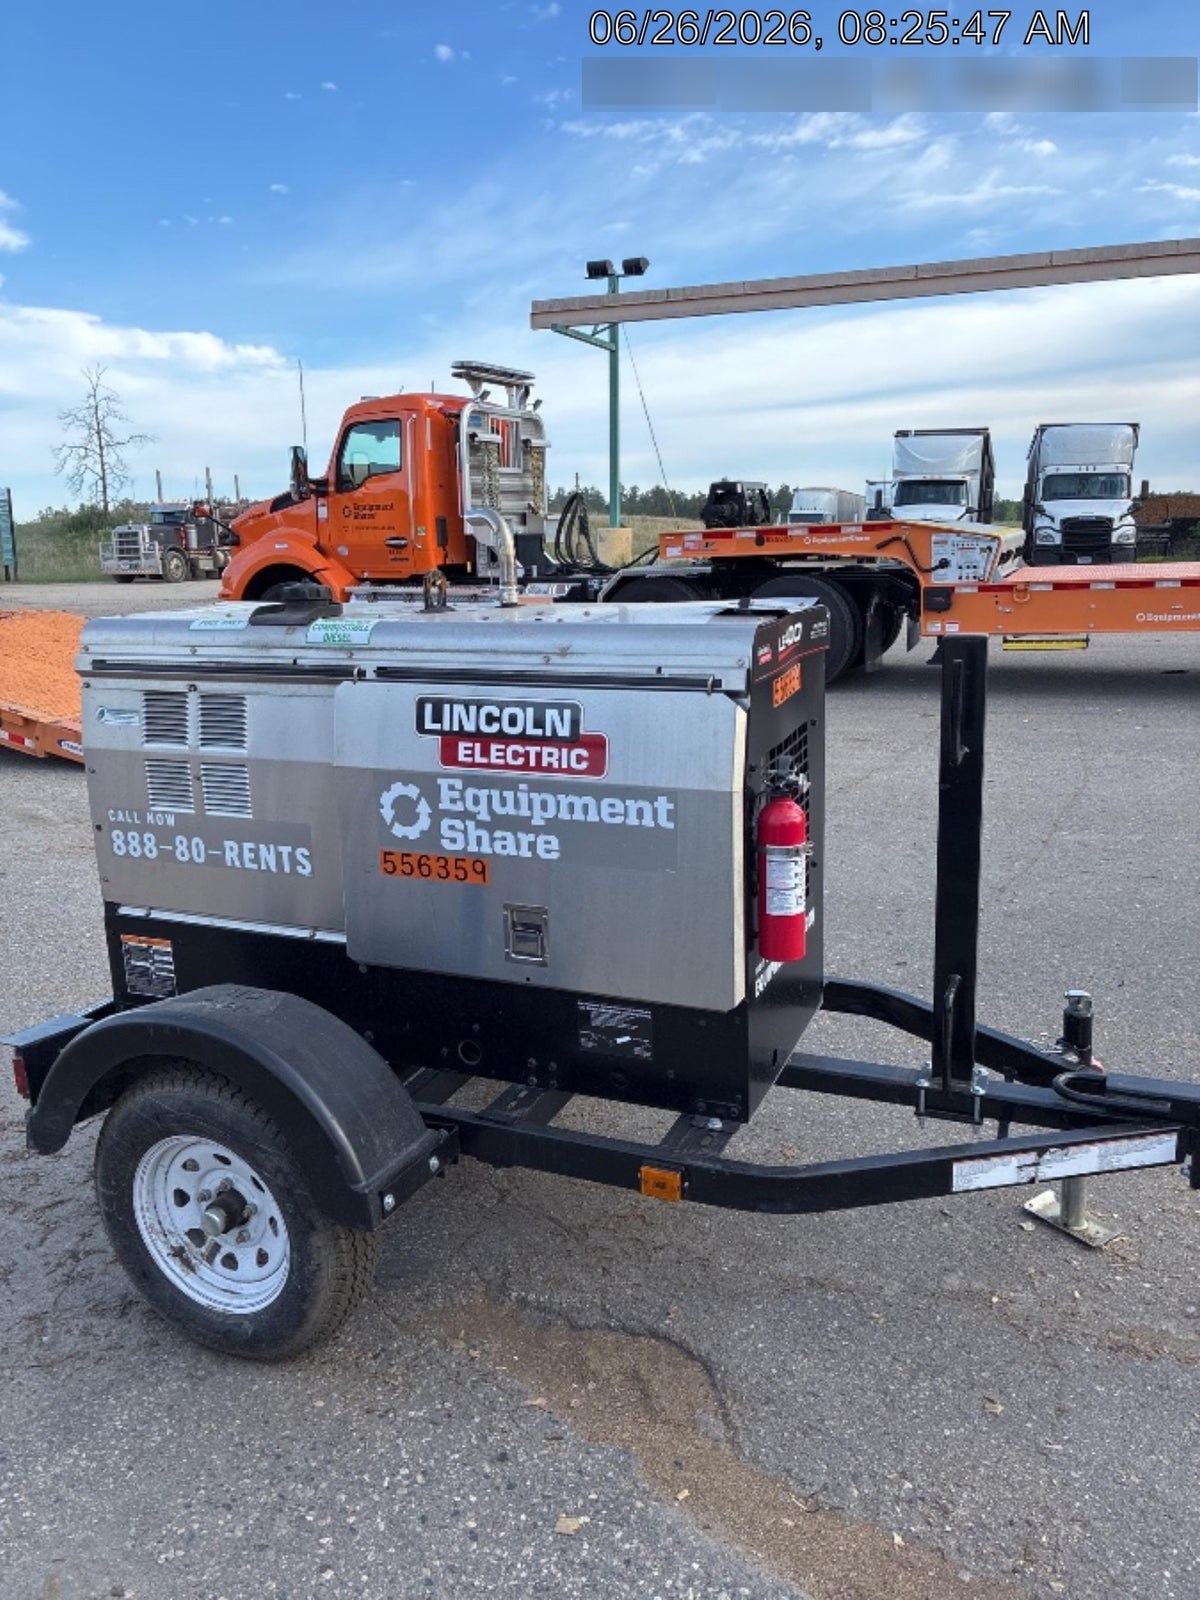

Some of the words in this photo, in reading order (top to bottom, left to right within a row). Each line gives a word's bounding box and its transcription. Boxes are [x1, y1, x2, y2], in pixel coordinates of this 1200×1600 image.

[424, 702, 572, 737] LINCOLN
[457, 741, 589, 770] ELECTRIC
[107, 808, 141, 824] CALL
[437, 777, 675, 829] Equipment
[110, 829, 313, 877] 888-80-RENTS
[439, 818, 561, 860] Share
[382, 850, 487, 883] 556359
